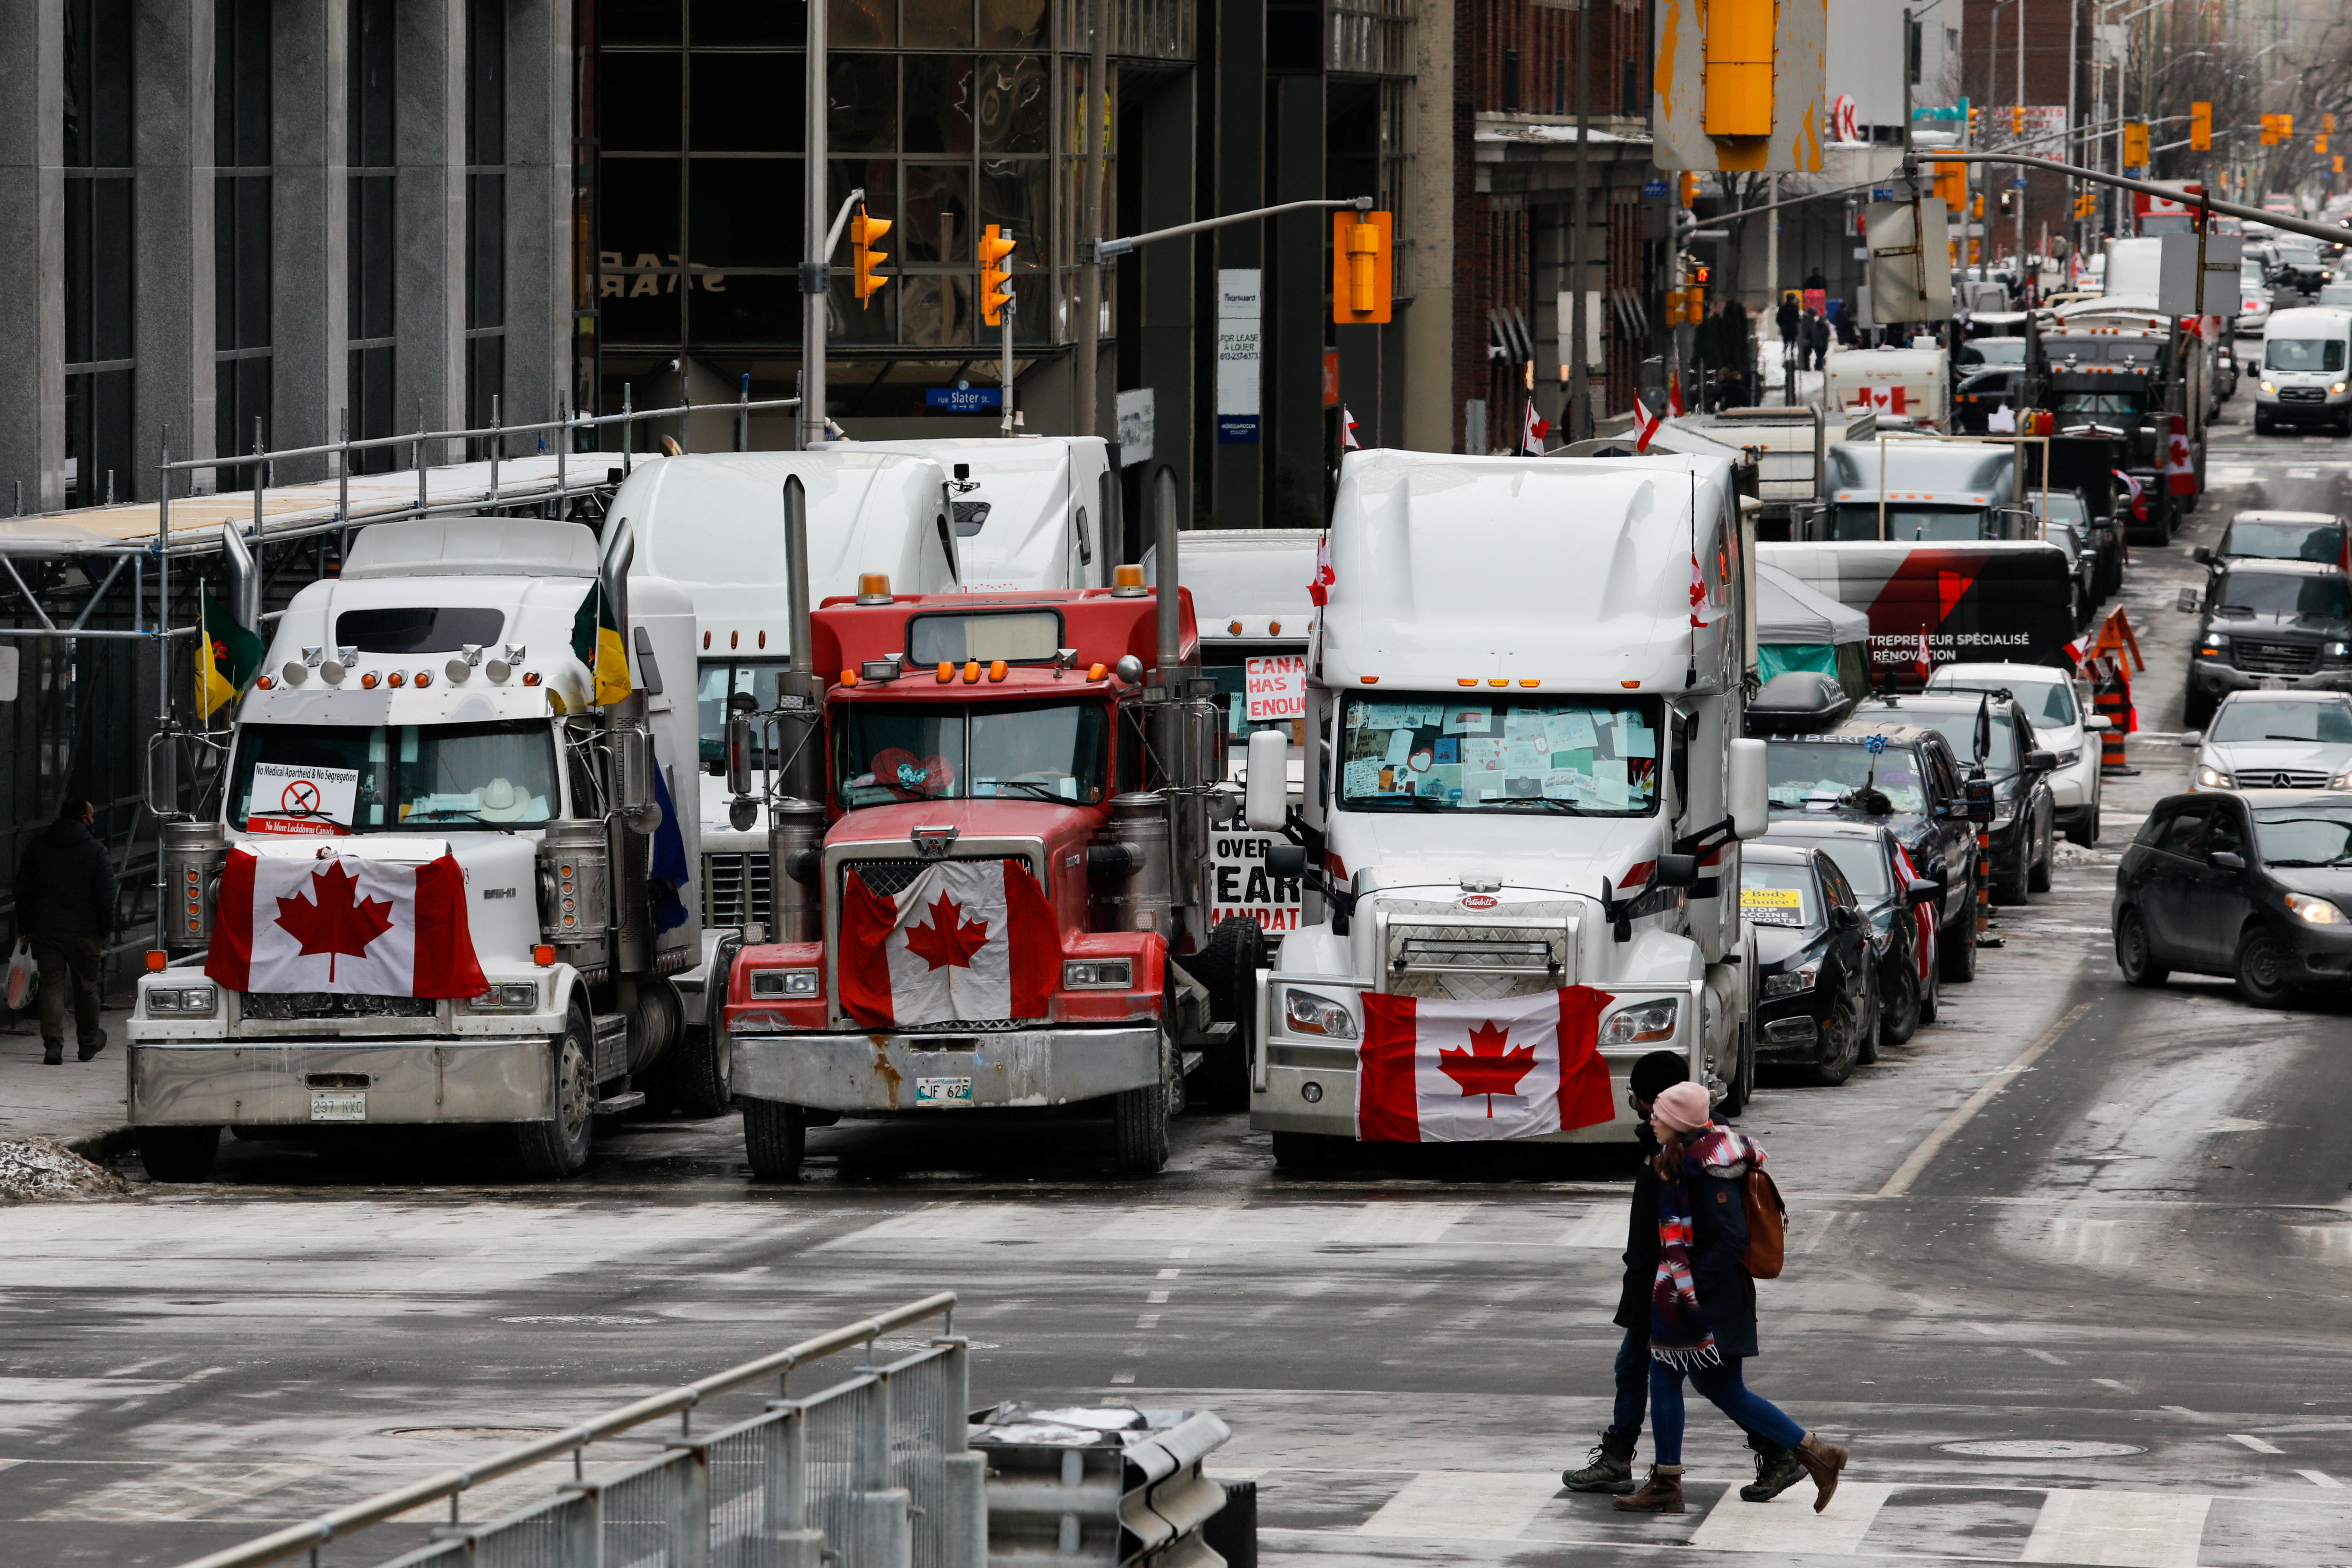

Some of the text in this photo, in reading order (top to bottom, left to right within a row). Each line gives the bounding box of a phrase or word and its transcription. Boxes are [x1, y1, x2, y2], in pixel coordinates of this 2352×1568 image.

[1220, 334, 1235, 342] FOR
[1231, 343, 1254, 351] LOUER
[951, 391, 979, 403] Slater
[1869, 632, 2030, 646] TREPREEUR SPÉCIALISÉ
[1873, 649, 1956, 661] RÉNOVION
[1249, 676, 1287, 693] HAS
[1348, 731, 1377, 744] Thank
[1771, 733, 1865, 744] LIBERT
[1356, 741, 1369, 750] you
[256, 765, 356, 784] No Medical Apartheid & No Segregation
[265, 821, 334, 836] No More Lockdowns Canada
[1465, 897, 1495, 906] Peterbilt
[919, 1085, 969, 1098] CJF 625
[313, 1101, 363, 1113] 237 KXQ
